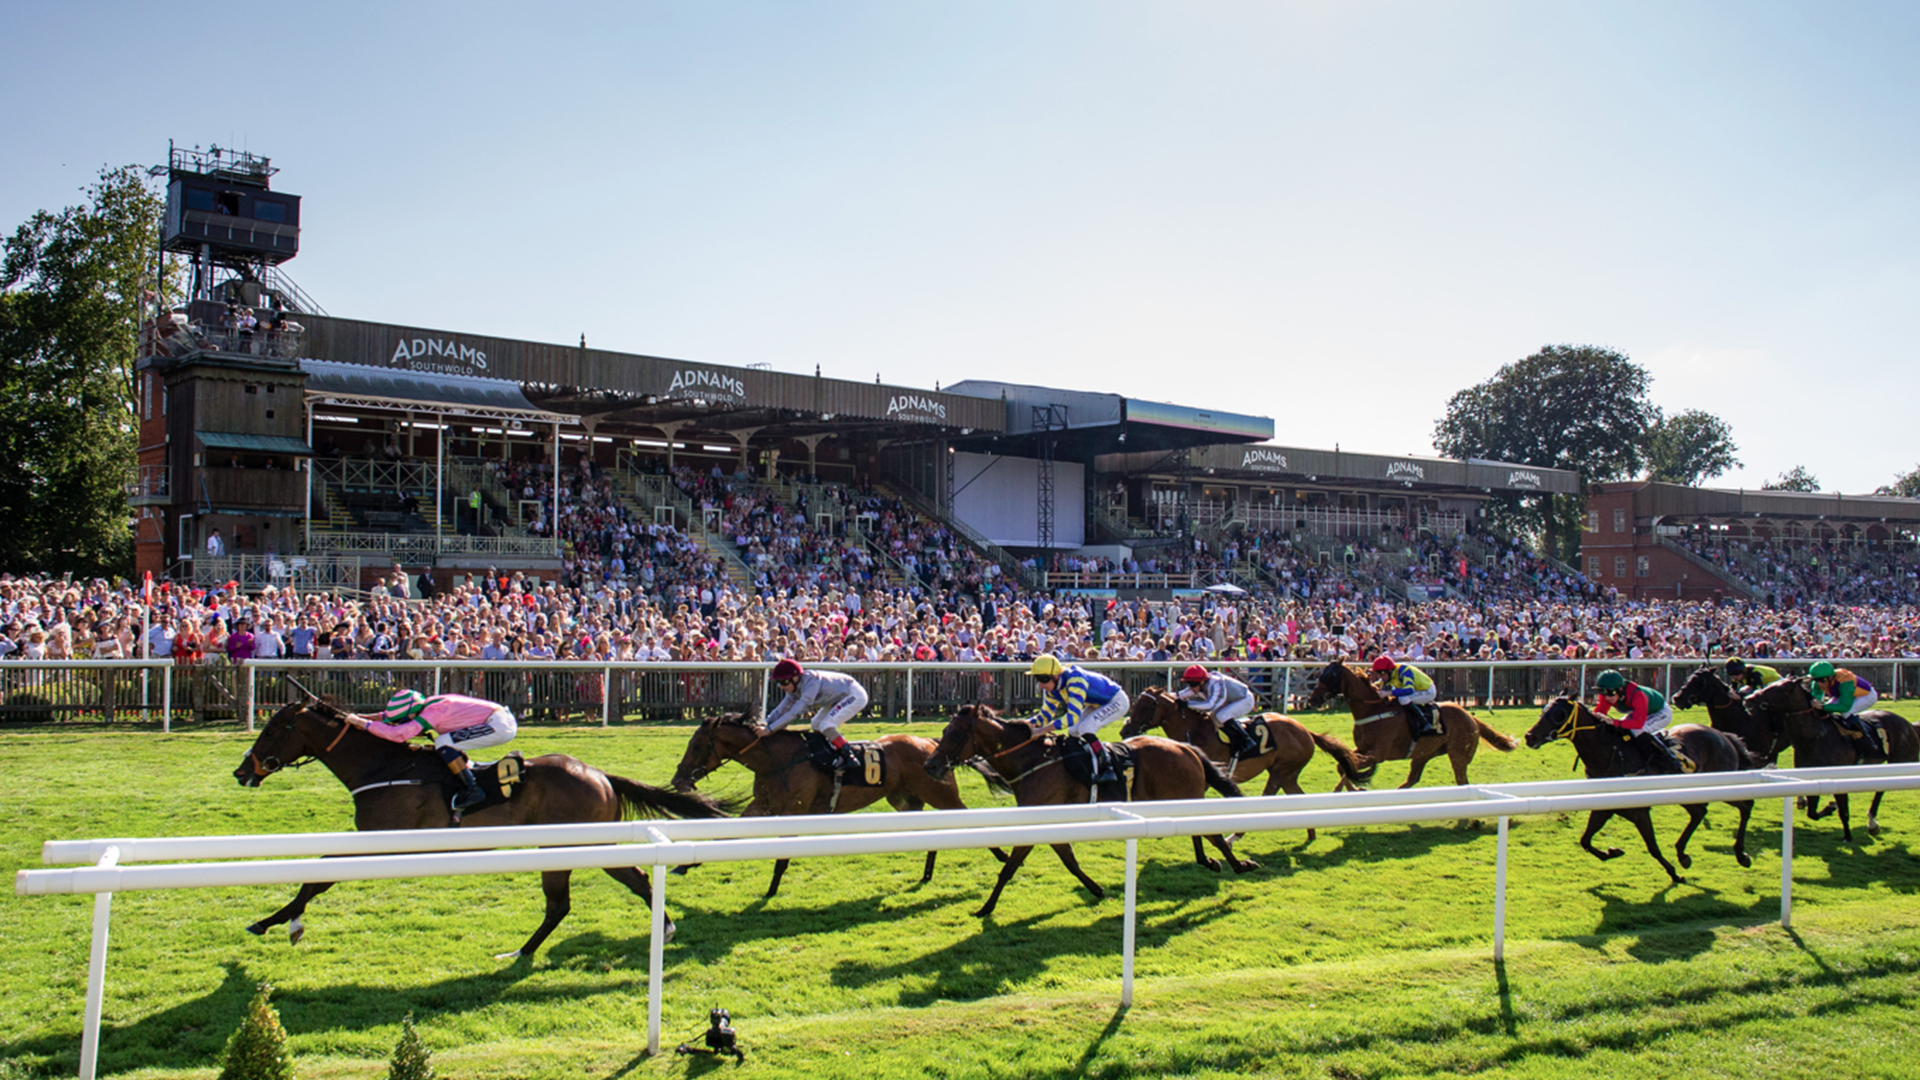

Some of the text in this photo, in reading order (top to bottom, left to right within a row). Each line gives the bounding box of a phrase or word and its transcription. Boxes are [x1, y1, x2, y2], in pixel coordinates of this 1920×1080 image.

[390, 338, 487, 370] ADNAMS
[410, 360, 473, 375] SOUTHWOLD
[668, 370, 744, 397] ADNAMS
[683, 389, 733, 402] SOUTHWOLD
[886, 395, 946, 419] ADNAMS
[1241, 449, 1287, 468] ADNAMS
[1385, 461, 1424, 479] ADNAMS
[1255, 724, 1274, 754] 2
[497, 758, 520, 798] 9
